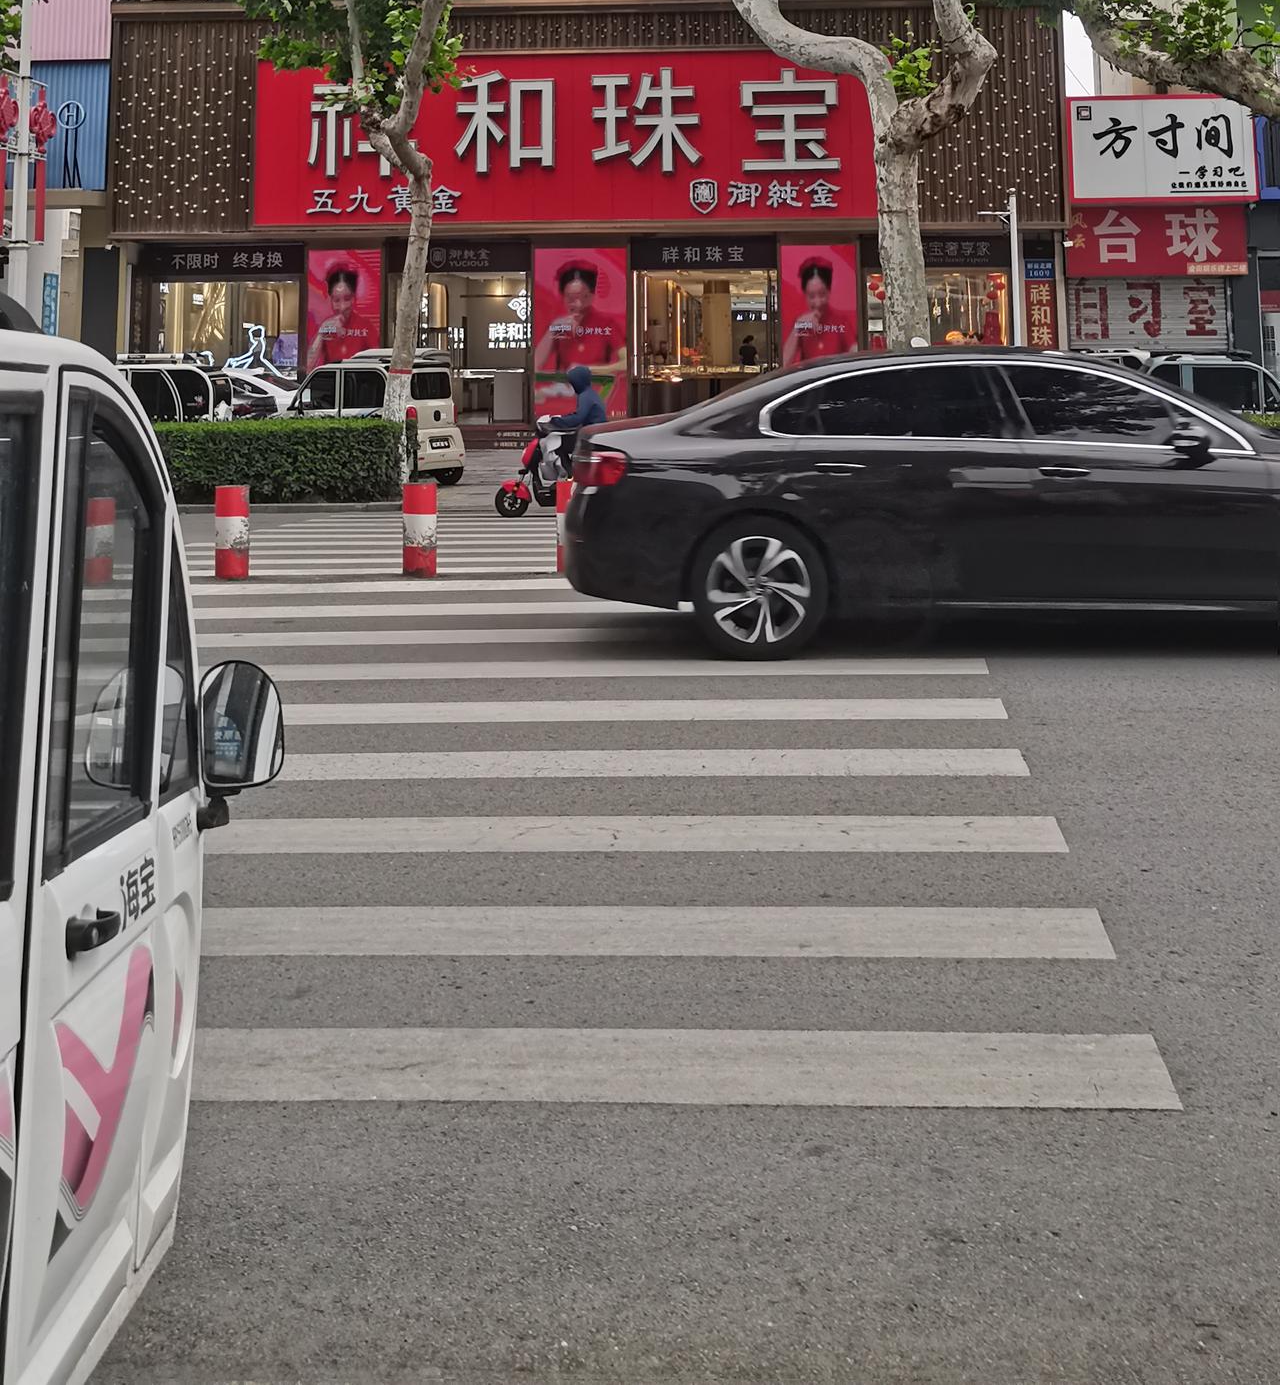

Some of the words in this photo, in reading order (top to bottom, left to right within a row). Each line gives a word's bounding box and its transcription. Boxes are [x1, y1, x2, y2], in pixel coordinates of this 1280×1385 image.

[1092, 113, 1233, 159] 方寸间
[171, 253, 219, 270] 不限时
[232, 251, 283, 269] 终身换
[662, 245, 744, 263] 祥和珠宝
[1093, 208, 1222, 263] 台球
[1030, 283, 1052, 346] 祥和珠
[1074, 276, 1218, 340] 自习室
[119, 855, 157, 933] 海宝
